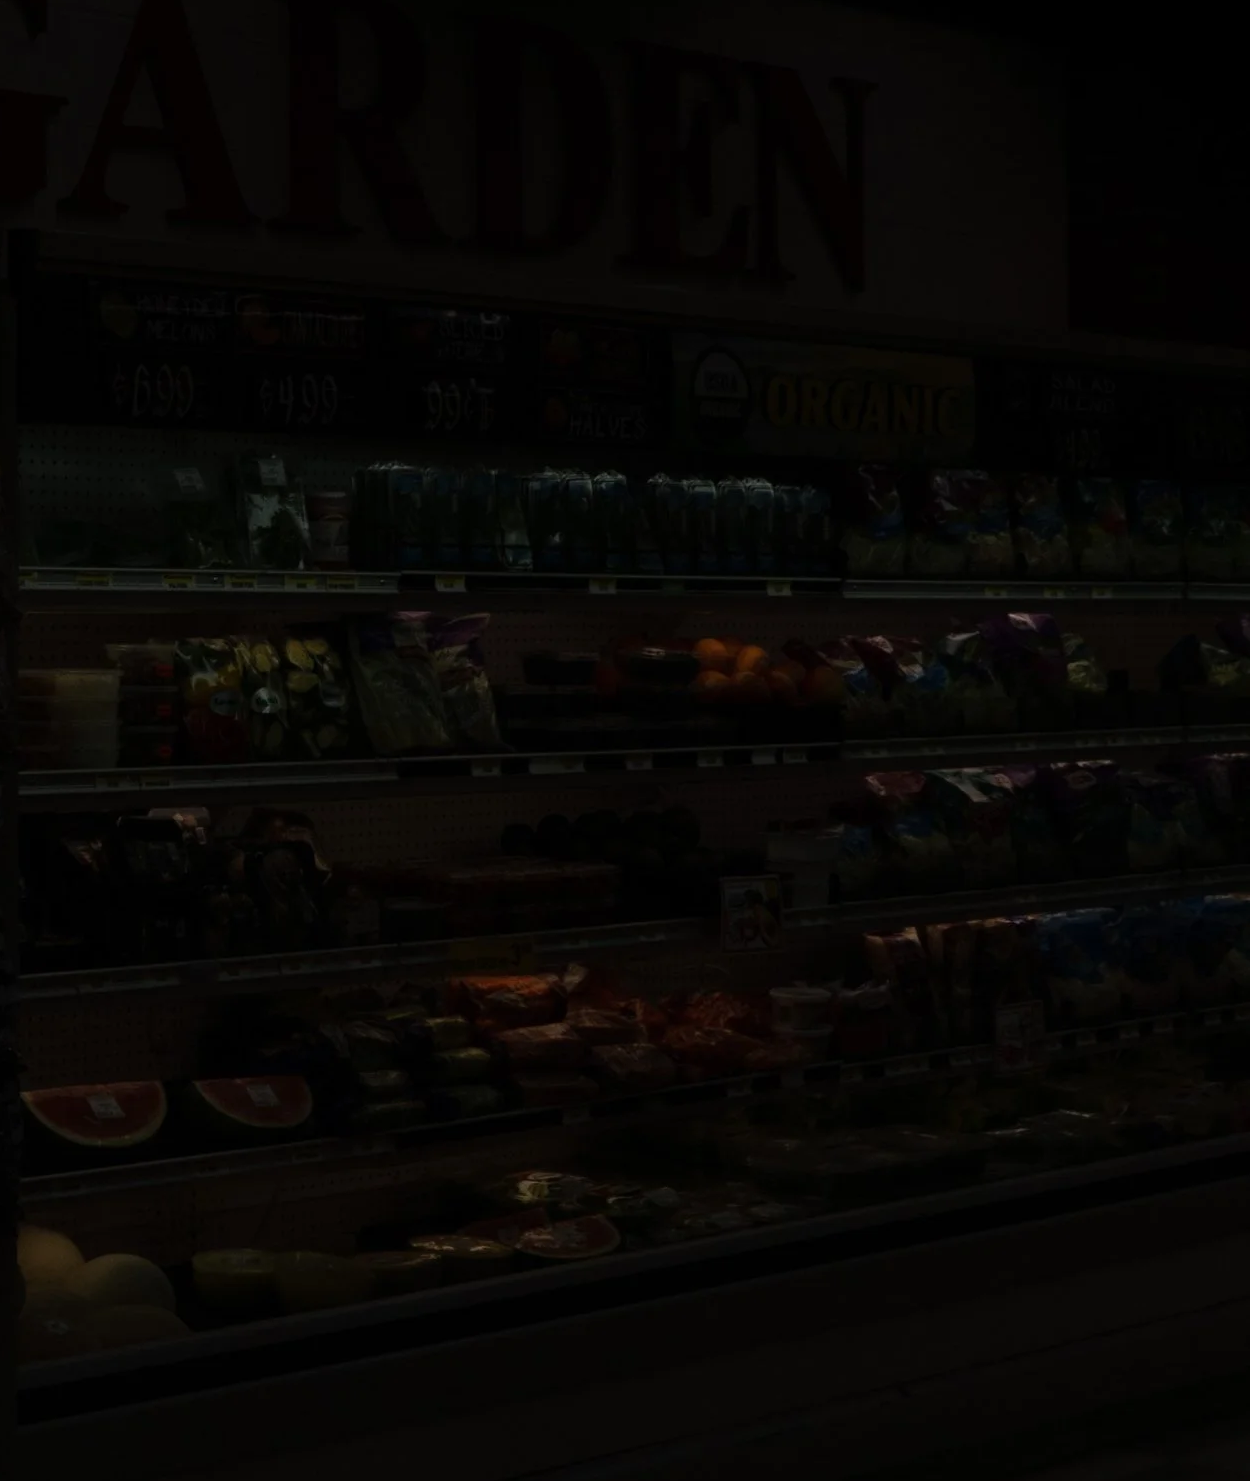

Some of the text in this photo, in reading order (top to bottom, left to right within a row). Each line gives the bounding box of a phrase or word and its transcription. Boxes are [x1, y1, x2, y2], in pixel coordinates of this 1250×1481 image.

[145, 318, 217, 345] MELONS
[1049, 370, 1116, 395] SALAD
[765, 371, 962, 439] ORGANIC
[568, 413, 649, 442] HALVES
